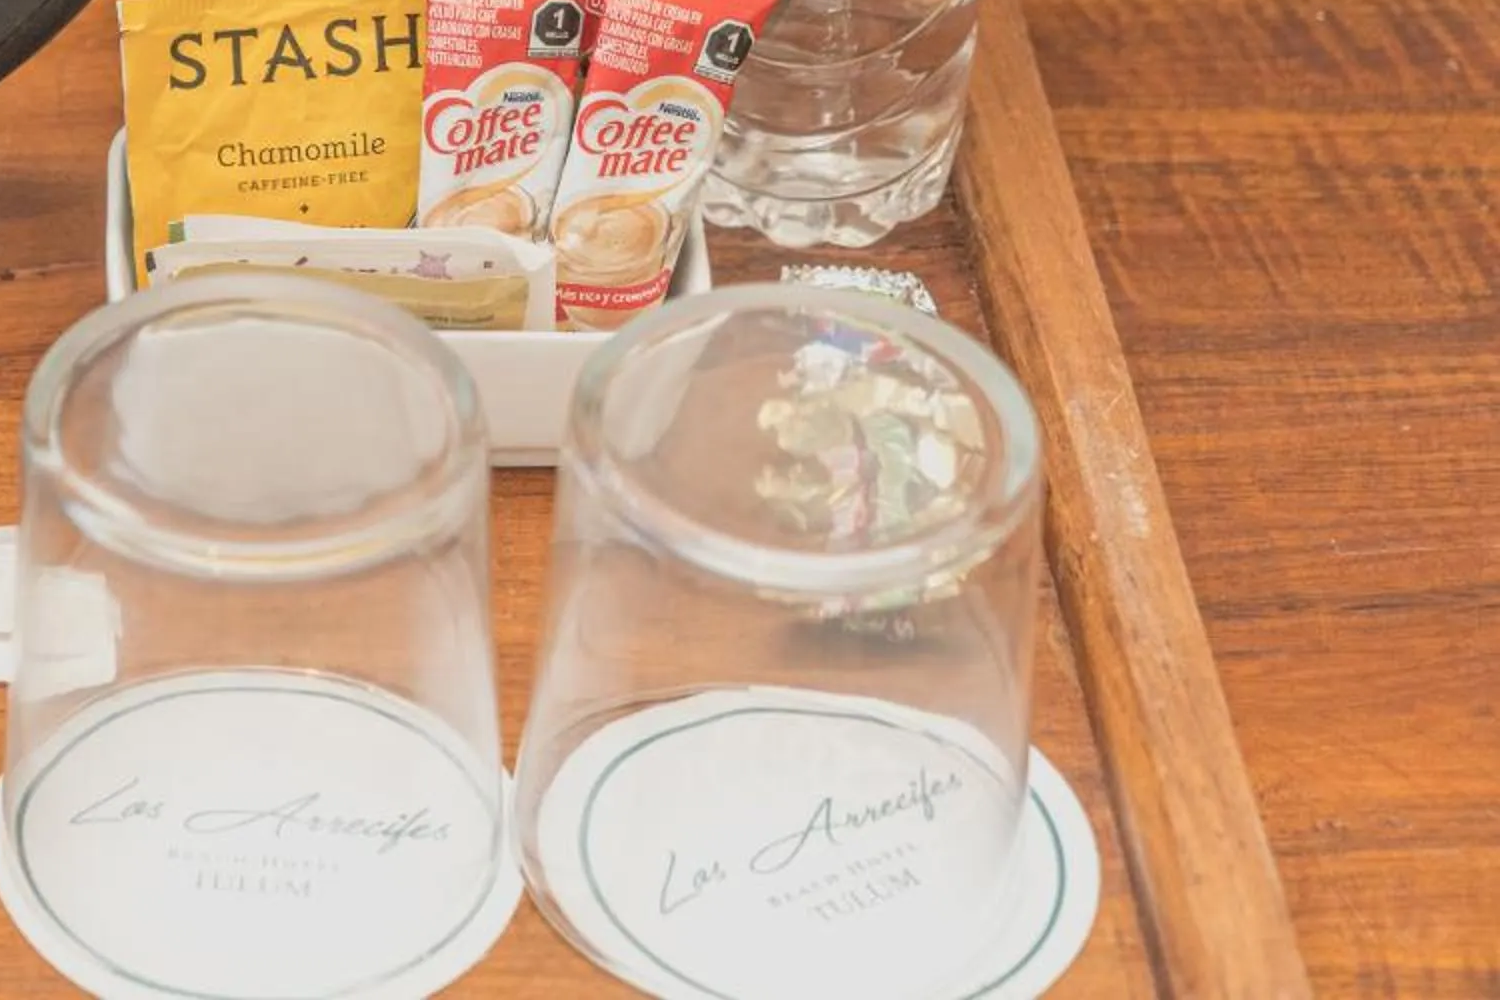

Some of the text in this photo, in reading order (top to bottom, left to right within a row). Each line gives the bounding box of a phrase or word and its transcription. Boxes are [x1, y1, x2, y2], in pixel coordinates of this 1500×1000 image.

[553, 8, 565, 29] 1
[727, 33, 740, 53] 1
[169, 13, 423, 89] STASH
[217, 133, 385, 168] Chamomile
[425, 97, 541, 155] Coffee
[576, 99, 696, 154] Coffee
[454, 131, 540, 176] mate
[598, 149, 688, 177] mate
[70, 775, 452, 855] Las Arrecifes
[660, 766, 963, 915] Las Arrecifes
